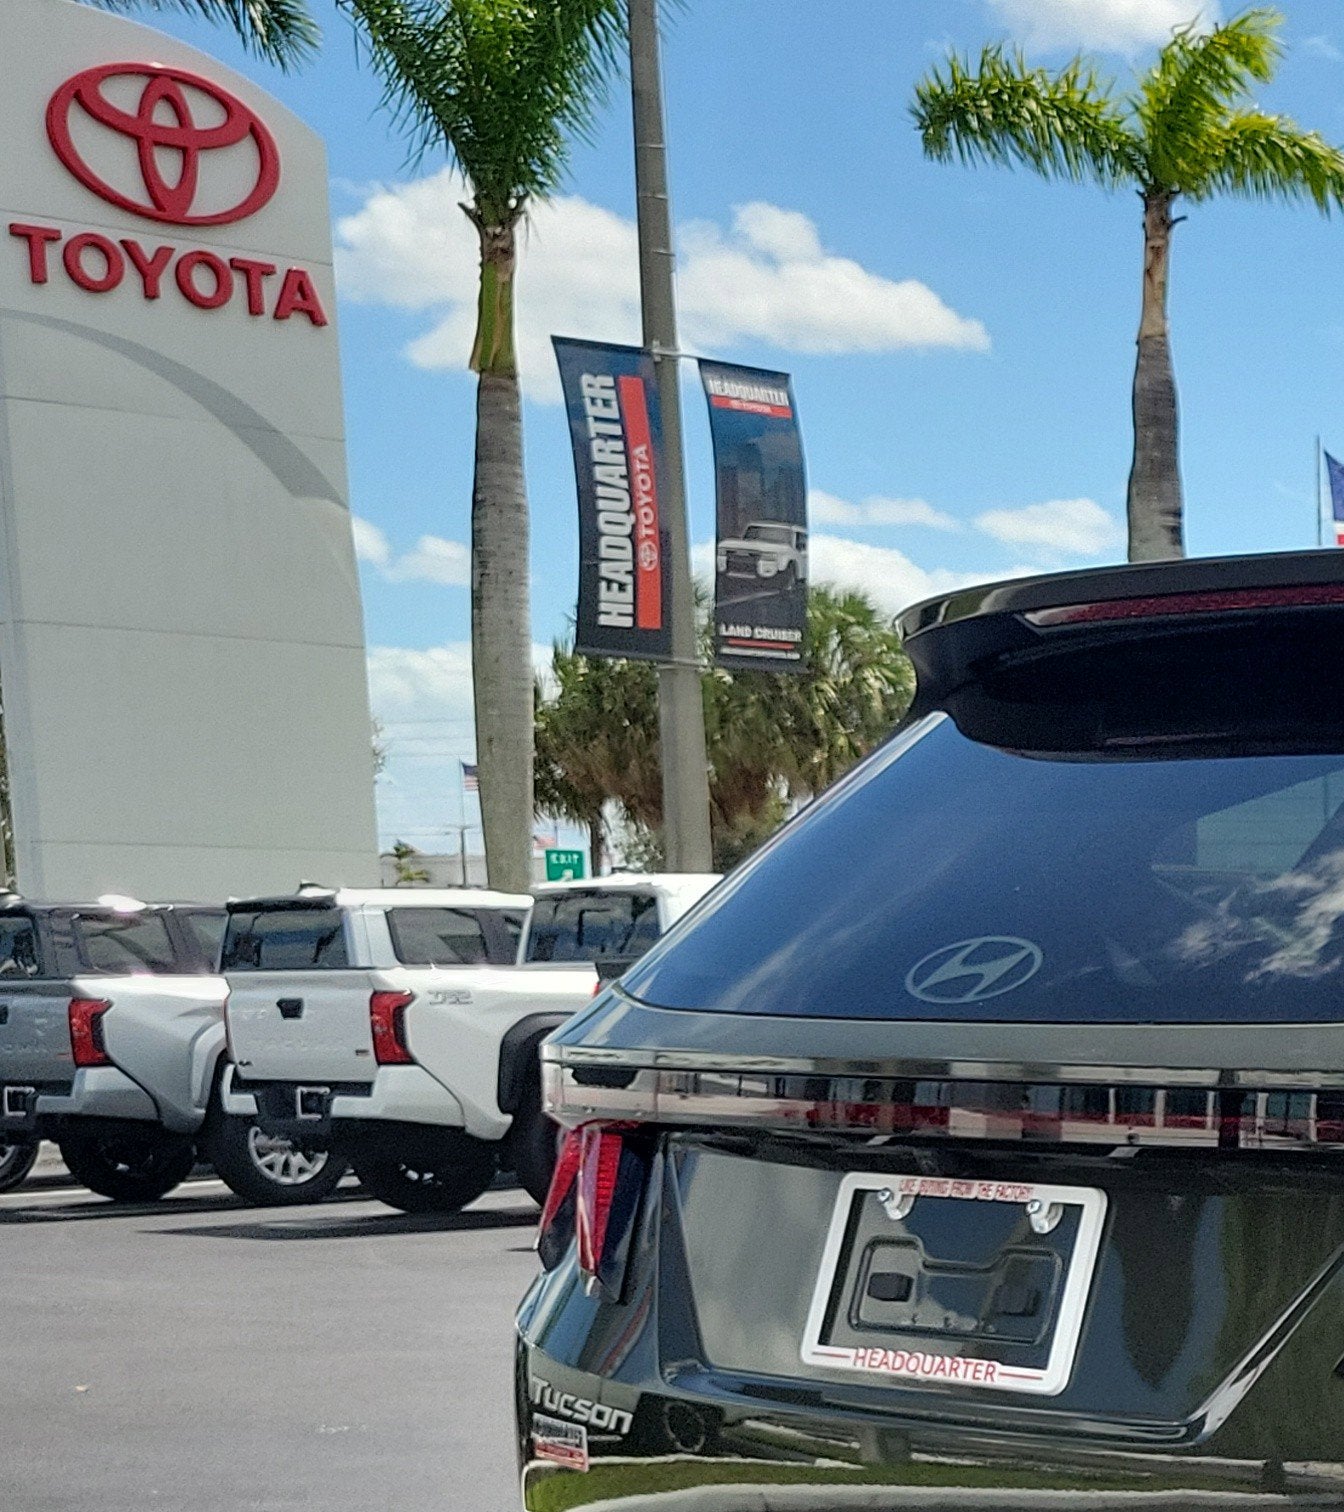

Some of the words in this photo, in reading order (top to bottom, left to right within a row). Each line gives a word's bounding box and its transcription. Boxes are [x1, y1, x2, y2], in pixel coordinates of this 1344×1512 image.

[9, 223, 329, 327] TOYOTA
[580, 373, 636, 628] HEADQUARTER
[633, 443, 656, 538] TOYOTA
[720, 623, 752, 638] LAND
[853, 1347, 997, 1383] HEADQUARTER
